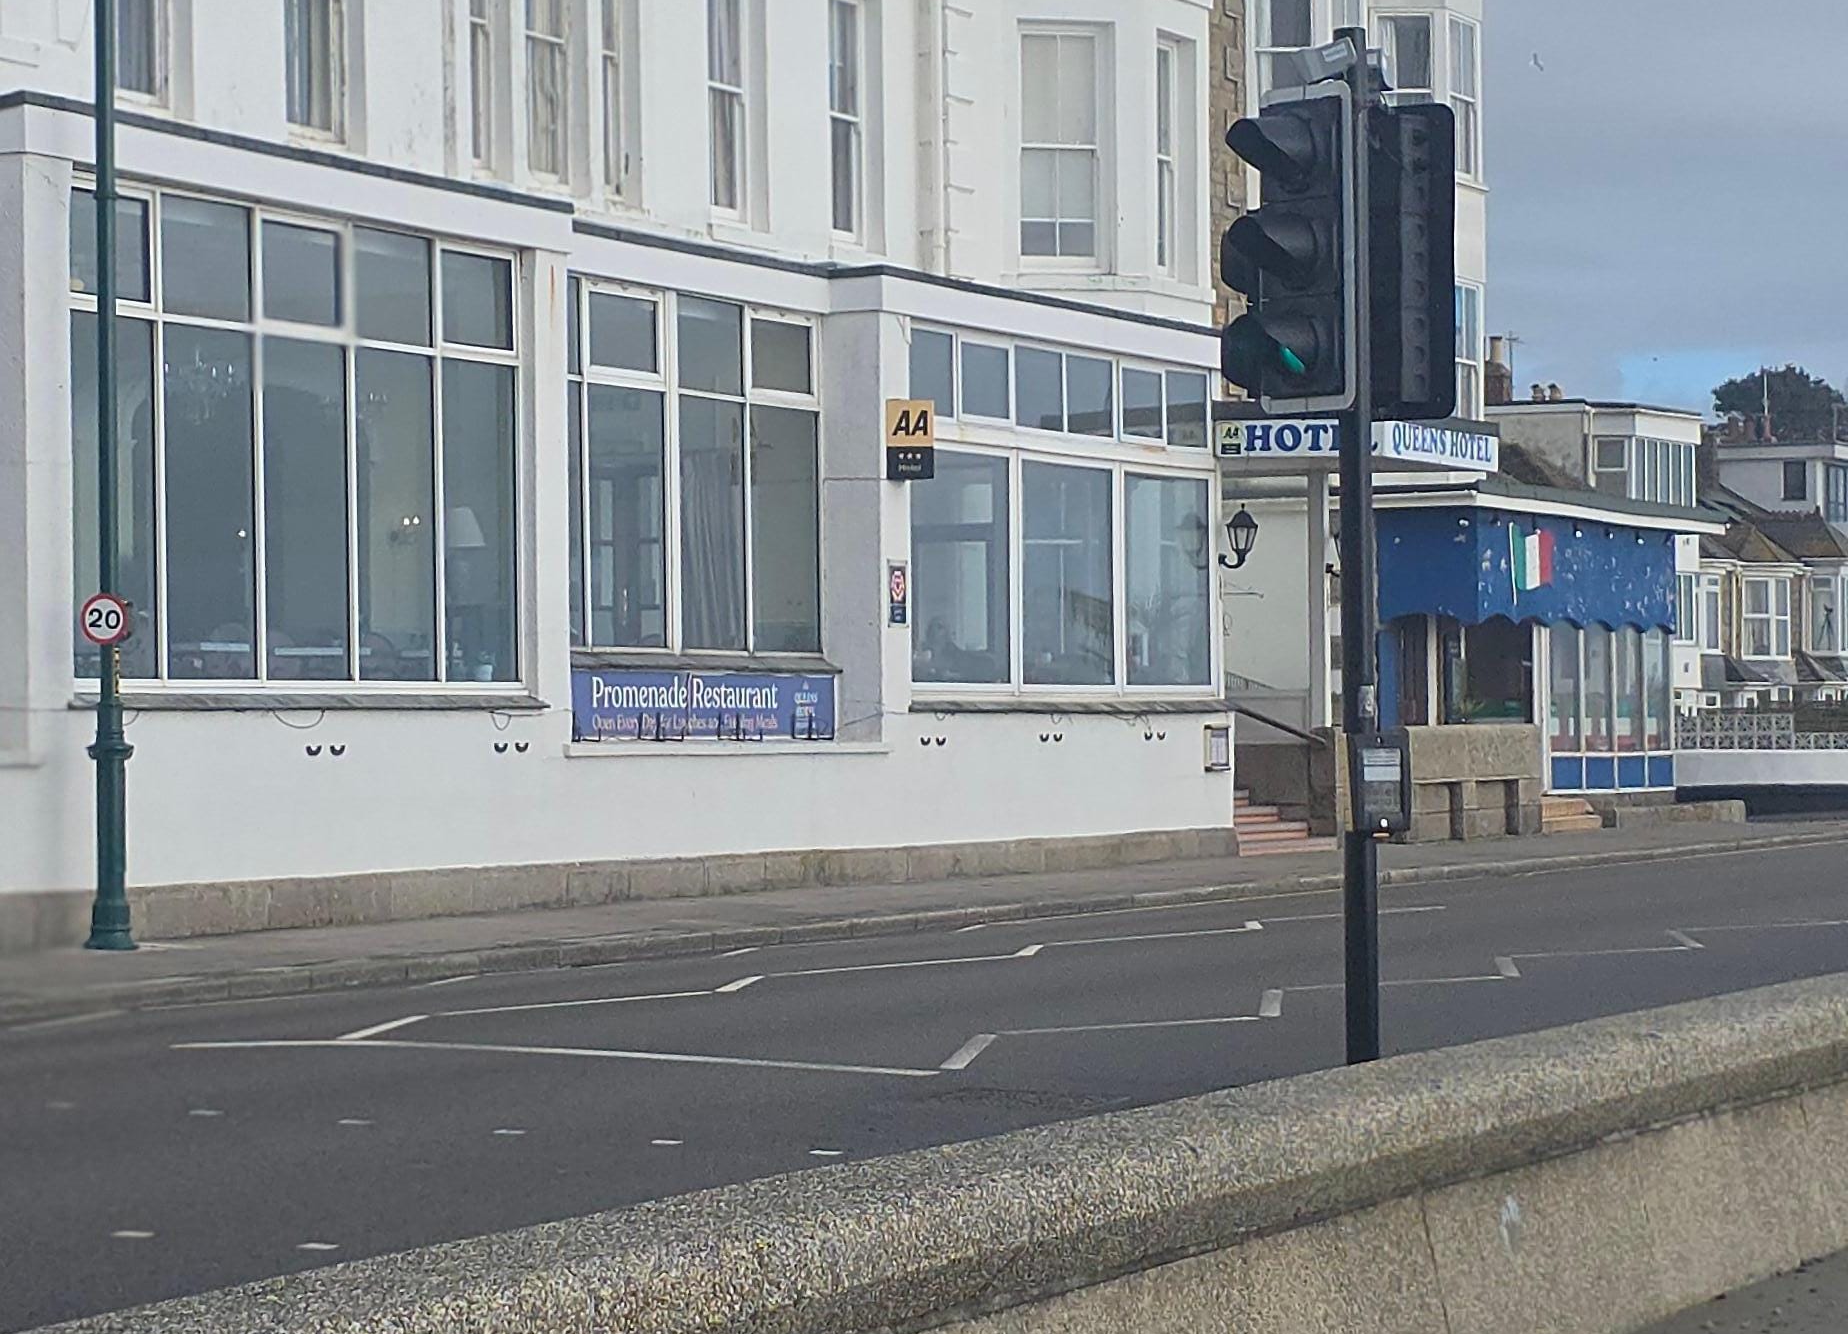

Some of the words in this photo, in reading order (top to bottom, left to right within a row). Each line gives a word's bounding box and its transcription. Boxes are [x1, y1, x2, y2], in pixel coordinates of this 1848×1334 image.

[892, 410, 928, 436] AA
[1393, 423, 1447, 455] QUEENS
[1450, 430, 1492, 463] HOTEL
[88, 608, 121, 629] 20
[591, 676, 688, 709] Promenade
[692, 677, 778, 709] Restaurant
